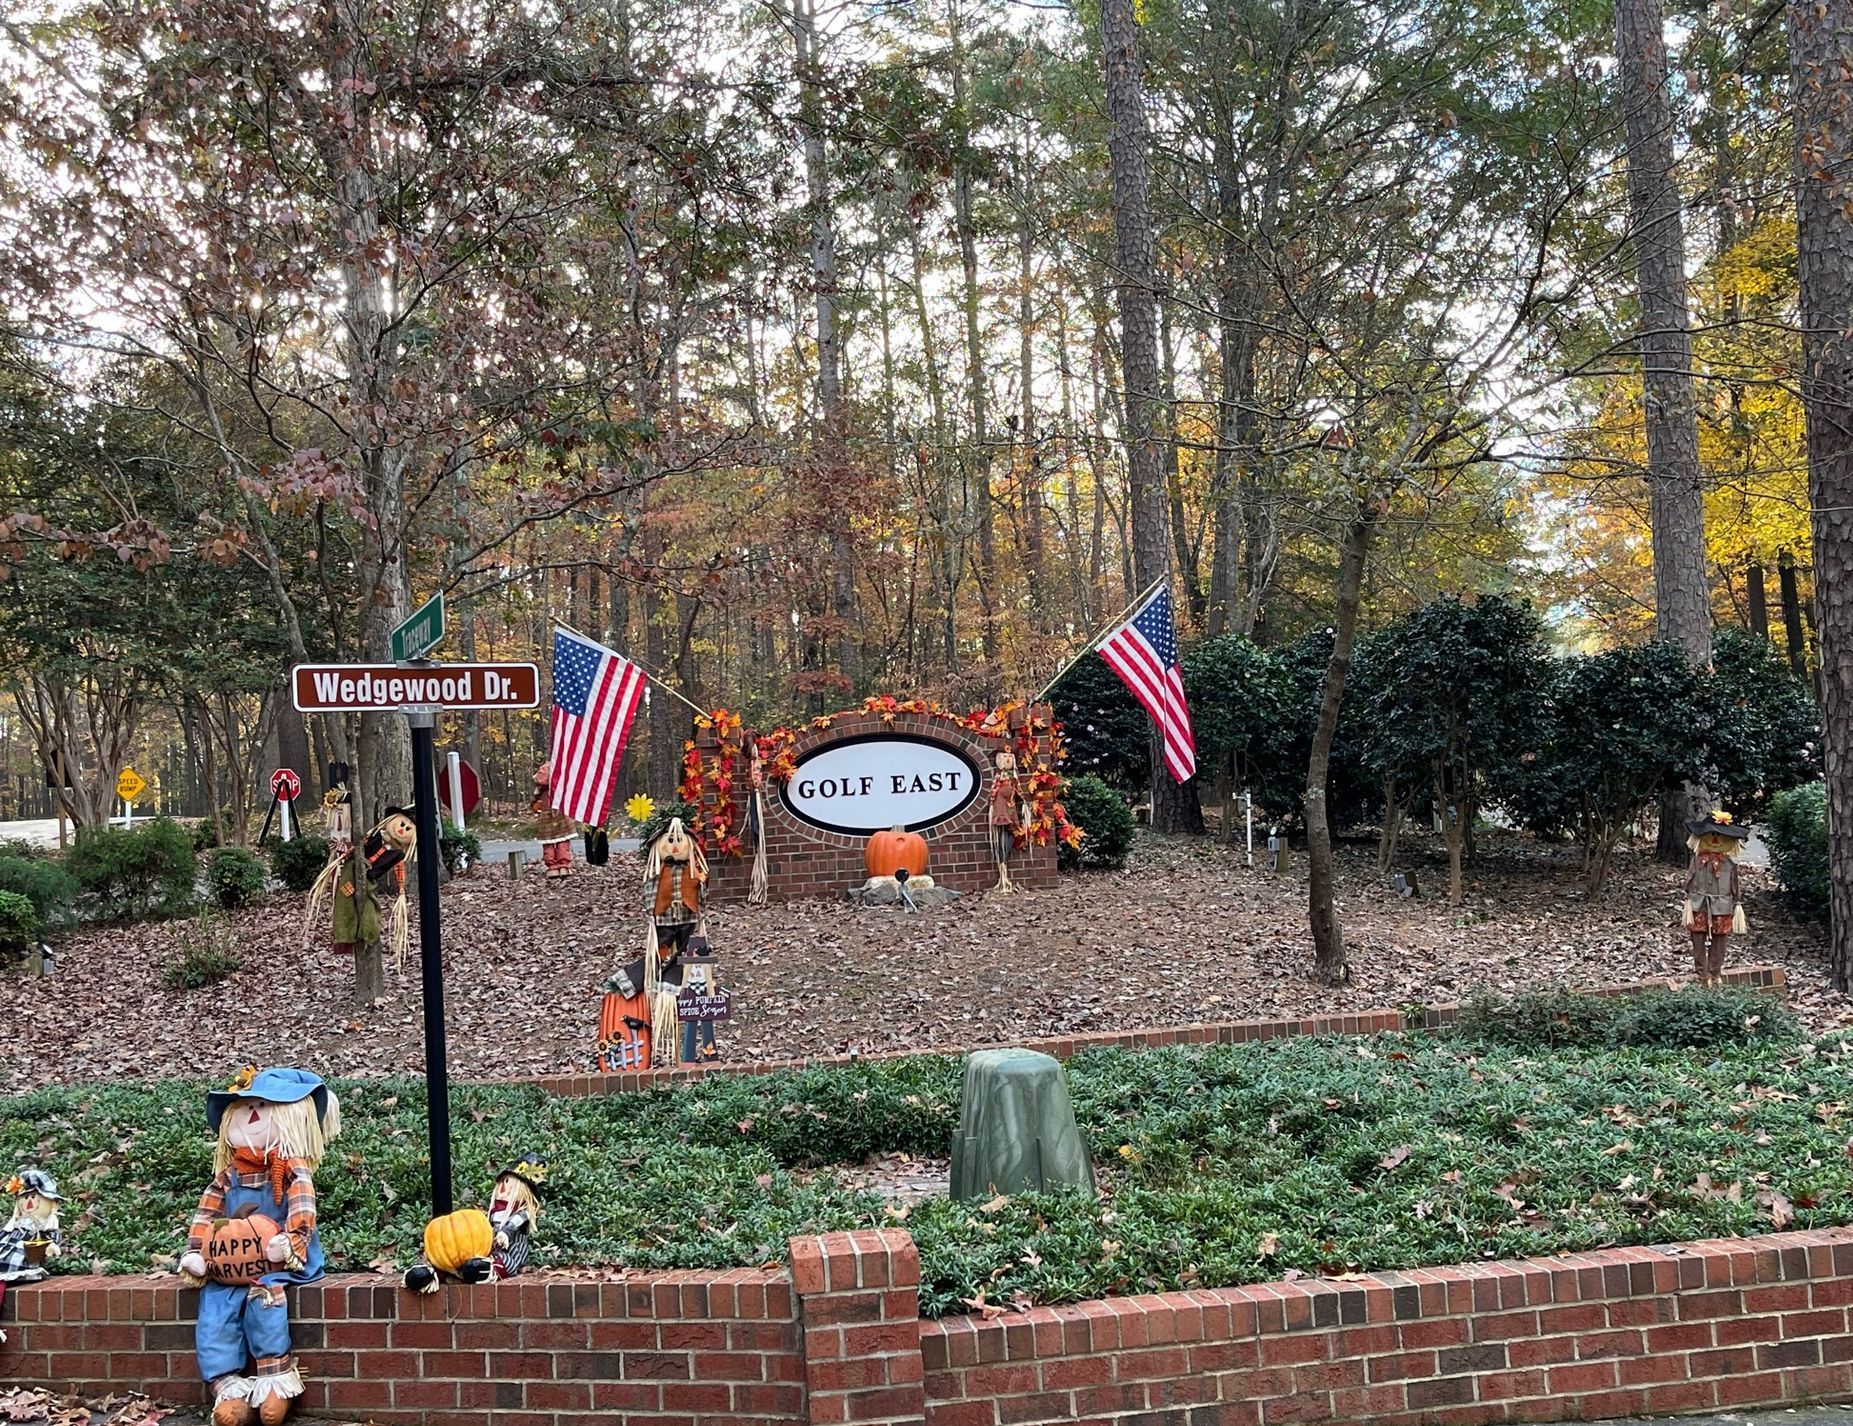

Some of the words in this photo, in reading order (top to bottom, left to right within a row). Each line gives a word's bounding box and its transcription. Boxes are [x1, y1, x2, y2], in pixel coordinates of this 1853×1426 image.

[313, 672, 471, 704] Wedgewood
[484, 671, 517, 700] Dr.
[798, 776, 874, 799] GOLF
[890, 772, 961, 794] EAST
[679, 1007, 700, 1016] SPICE
[209, 1237, 262, 1258] HAPPY
[206, 1259, 273, 1279] HARVEST
